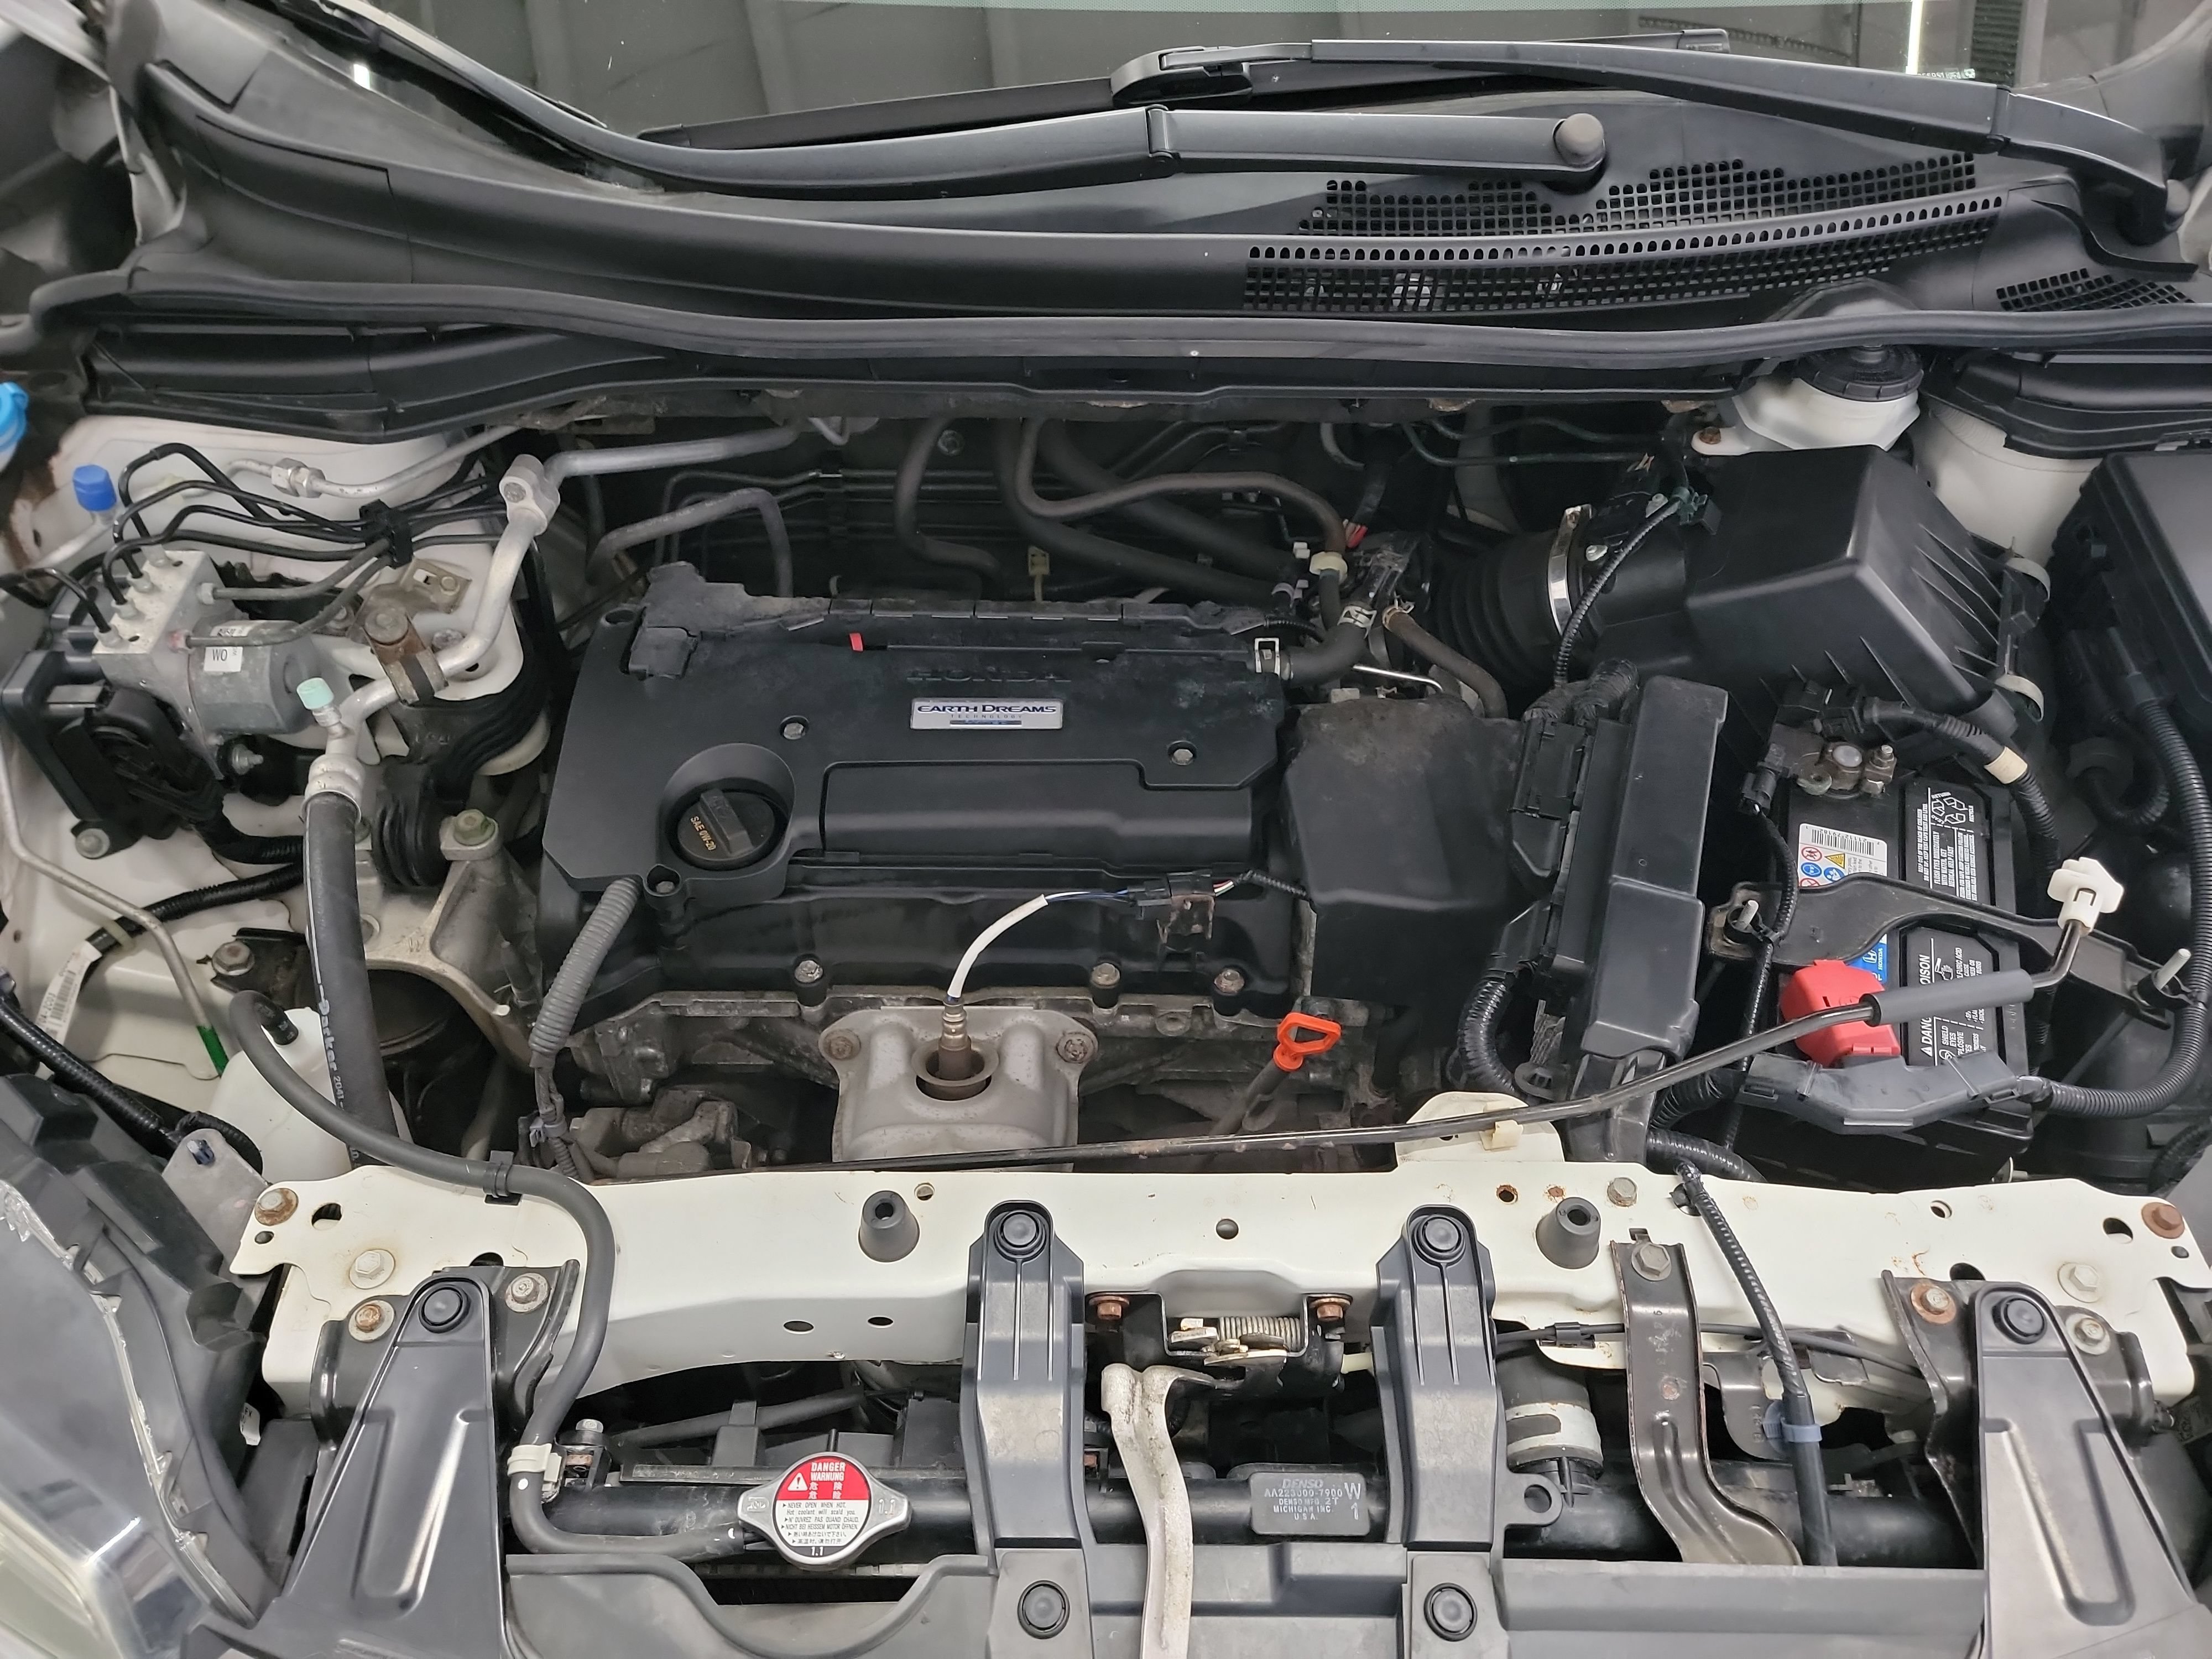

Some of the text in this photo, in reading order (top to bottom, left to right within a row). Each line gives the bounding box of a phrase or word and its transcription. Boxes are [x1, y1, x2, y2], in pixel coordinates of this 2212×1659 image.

[982, 705, 1057, 713] DREAMS
[691, 816, 705, 831] SAE
[1919, 954, 1931, 984] OISON
[811, 1462, 846, 1472] DANGER
[811, 1472, 844, 1481] WARNUNG
[1282, 1479, 1324, 1488] DENSO
[879, 1499, 895, 1515] 1.1
[811, 1546, 823, 1556] 1.1
